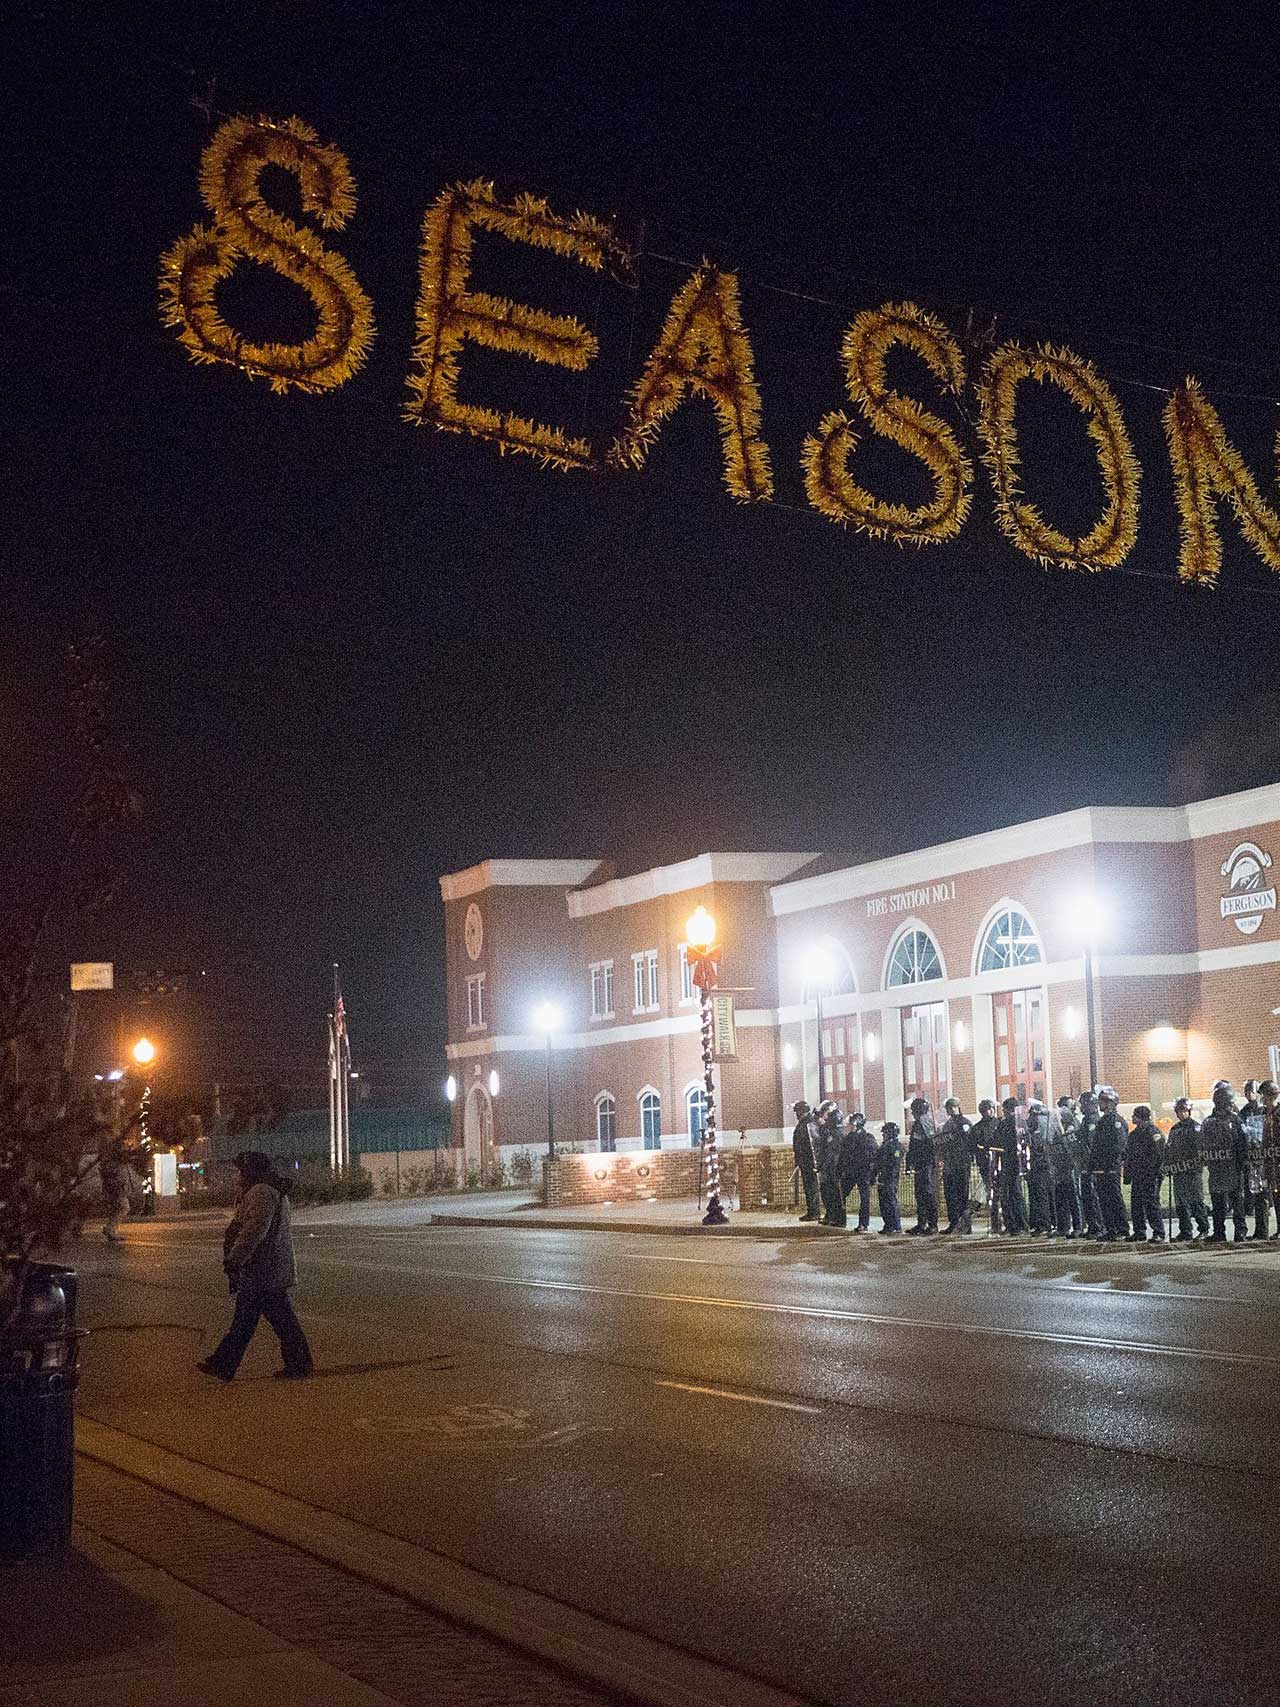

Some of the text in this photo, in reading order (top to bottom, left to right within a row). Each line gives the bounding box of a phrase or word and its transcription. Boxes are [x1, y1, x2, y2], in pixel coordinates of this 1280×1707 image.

[867, 898, 888, 917] FIRE
[890, 887, 930, 912] STATION
[1223, 892, 1273, 912] FERGUSON
[1198, 1149, 1233, 1160] POLICE
